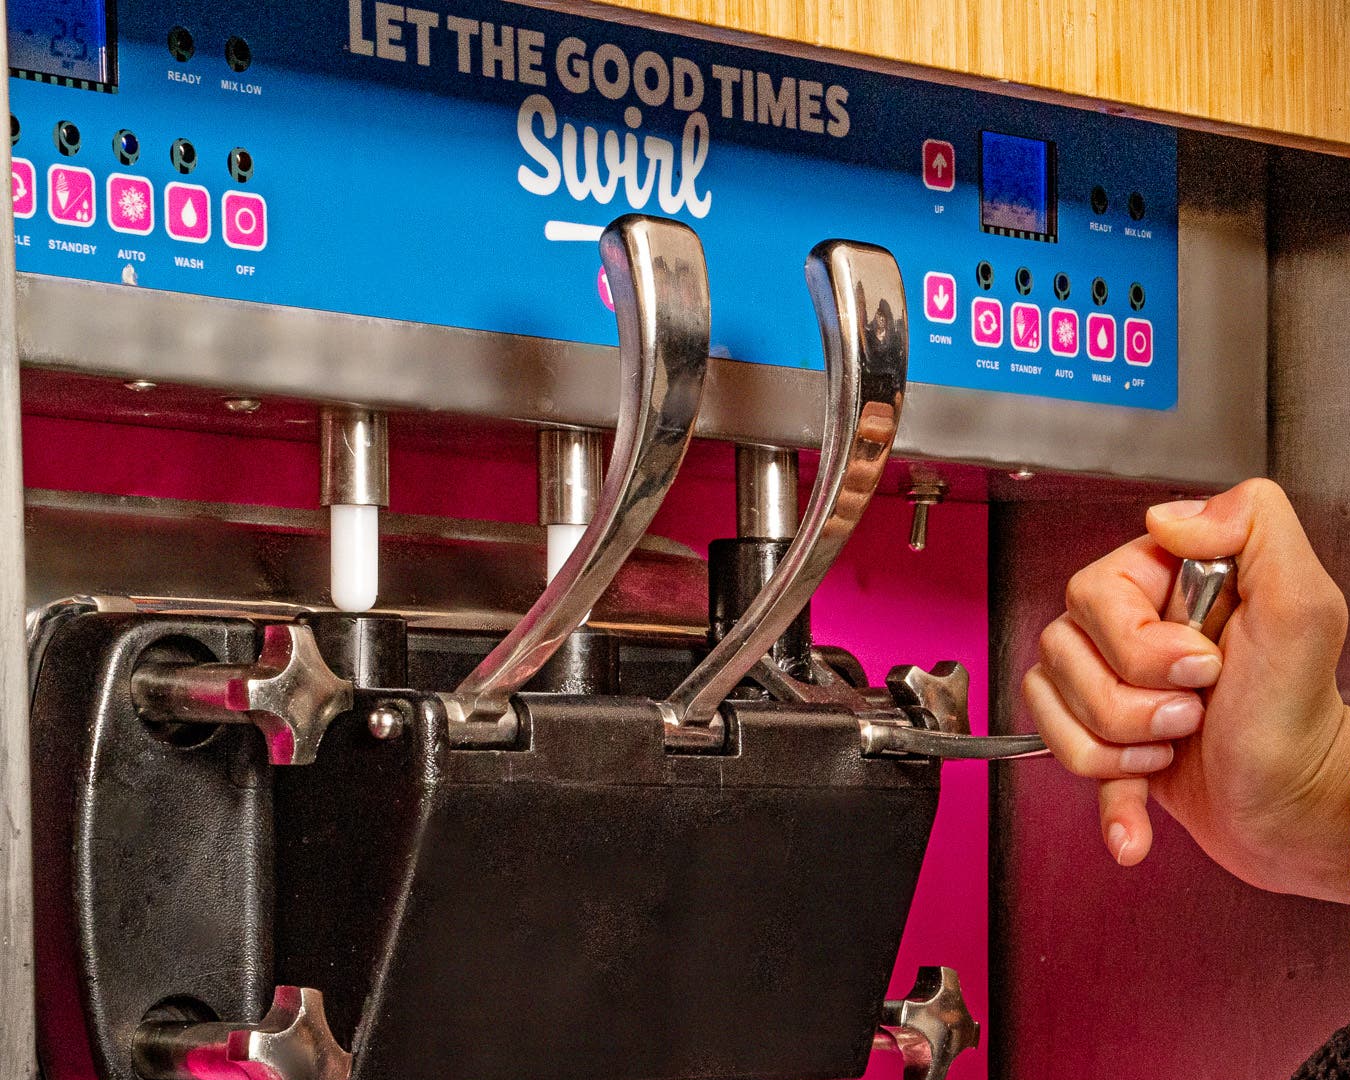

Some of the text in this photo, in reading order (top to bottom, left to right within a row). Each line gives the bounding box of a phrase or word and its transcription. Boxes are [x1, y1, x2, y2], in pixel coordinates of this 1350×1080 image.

[348, 0, 851, 139] LET THE GOOD TIMES
[167, 70, 202, 85] READY
[221, 79, 262, 96] MIX LOW
[517, 94, 712, 219] Swirl
[934, 204, 945, 215] UP
[1090, 221, 1112, 233] READY
[1124, 227, 1152, 240] MIX LOW
[48, 239, 97, 256] STANDBY
[117, 248, 146, 262] AUTO
[174, 256, 204, 270] WASH
[235, 264, 256, 276] OFF
[929, 333, 952, 345] DOWN
[976, 359, 1000, 370] CYCLE
[1010, 363, 1042, 375] STANDBY
[1055, 368, 1074, 379] AUTO
[1091, 373, 1112, 384] WASH
[1132, 378, 1145, 388] OFF
